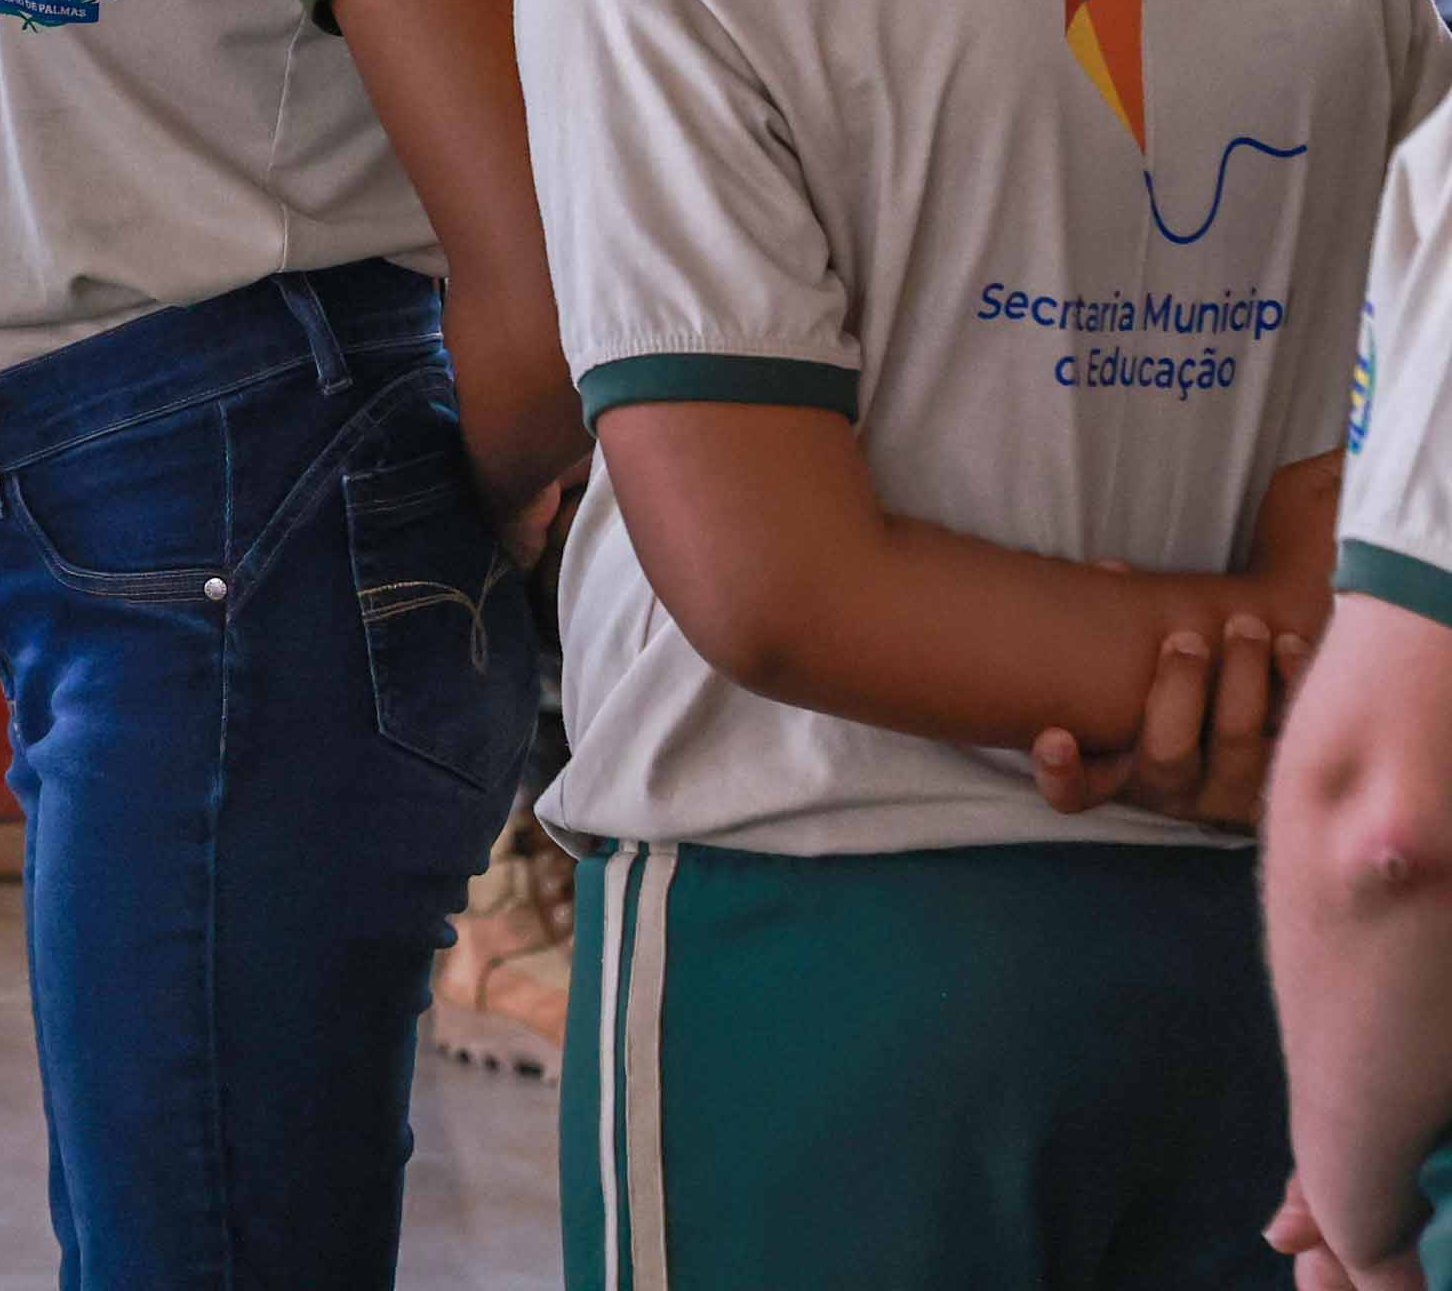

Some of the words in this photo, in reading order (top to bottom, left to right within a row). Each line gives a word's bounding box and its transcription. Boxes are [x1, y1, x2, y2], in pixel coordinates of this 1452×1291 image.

[25, 0, 38, 12] DE
[39, 3, 87, 18] PALMAS
[977, 282, 1135, 333] Secrtaria
[1143, 285, 1285, 341] Municip
[1086, 345, 1237, 401] Educação
